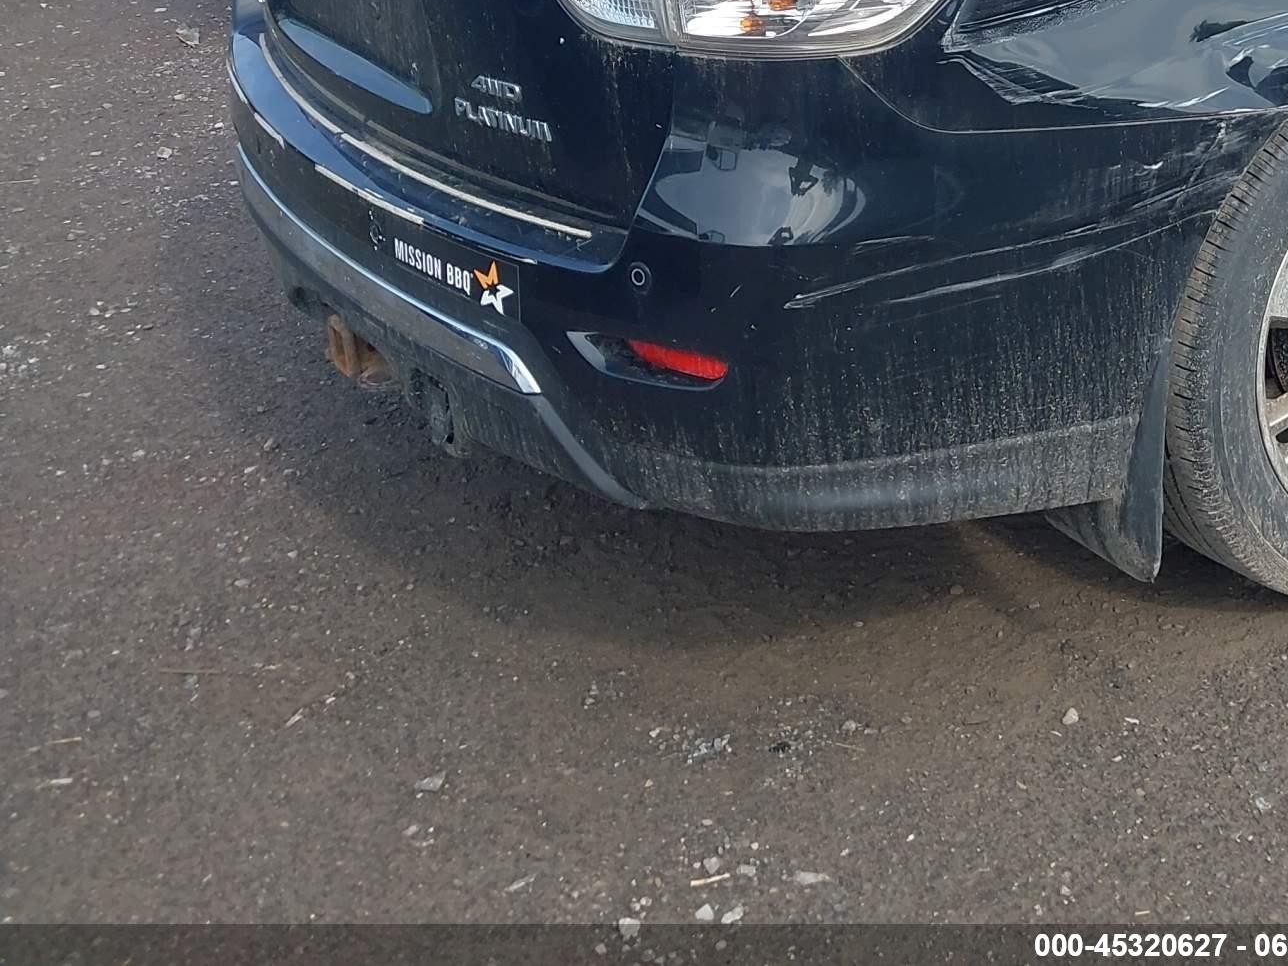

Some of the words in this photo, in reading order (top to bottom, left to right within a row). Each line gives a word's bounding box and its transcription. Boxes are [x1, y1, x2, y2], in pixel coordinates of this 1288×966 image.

[471, 75, 522, 103] 4WD
[454, 97, 552, 142] PLATINUM
[394, 237, 442, 280] MISSION
[446, 263, 472, 296] BBQ
